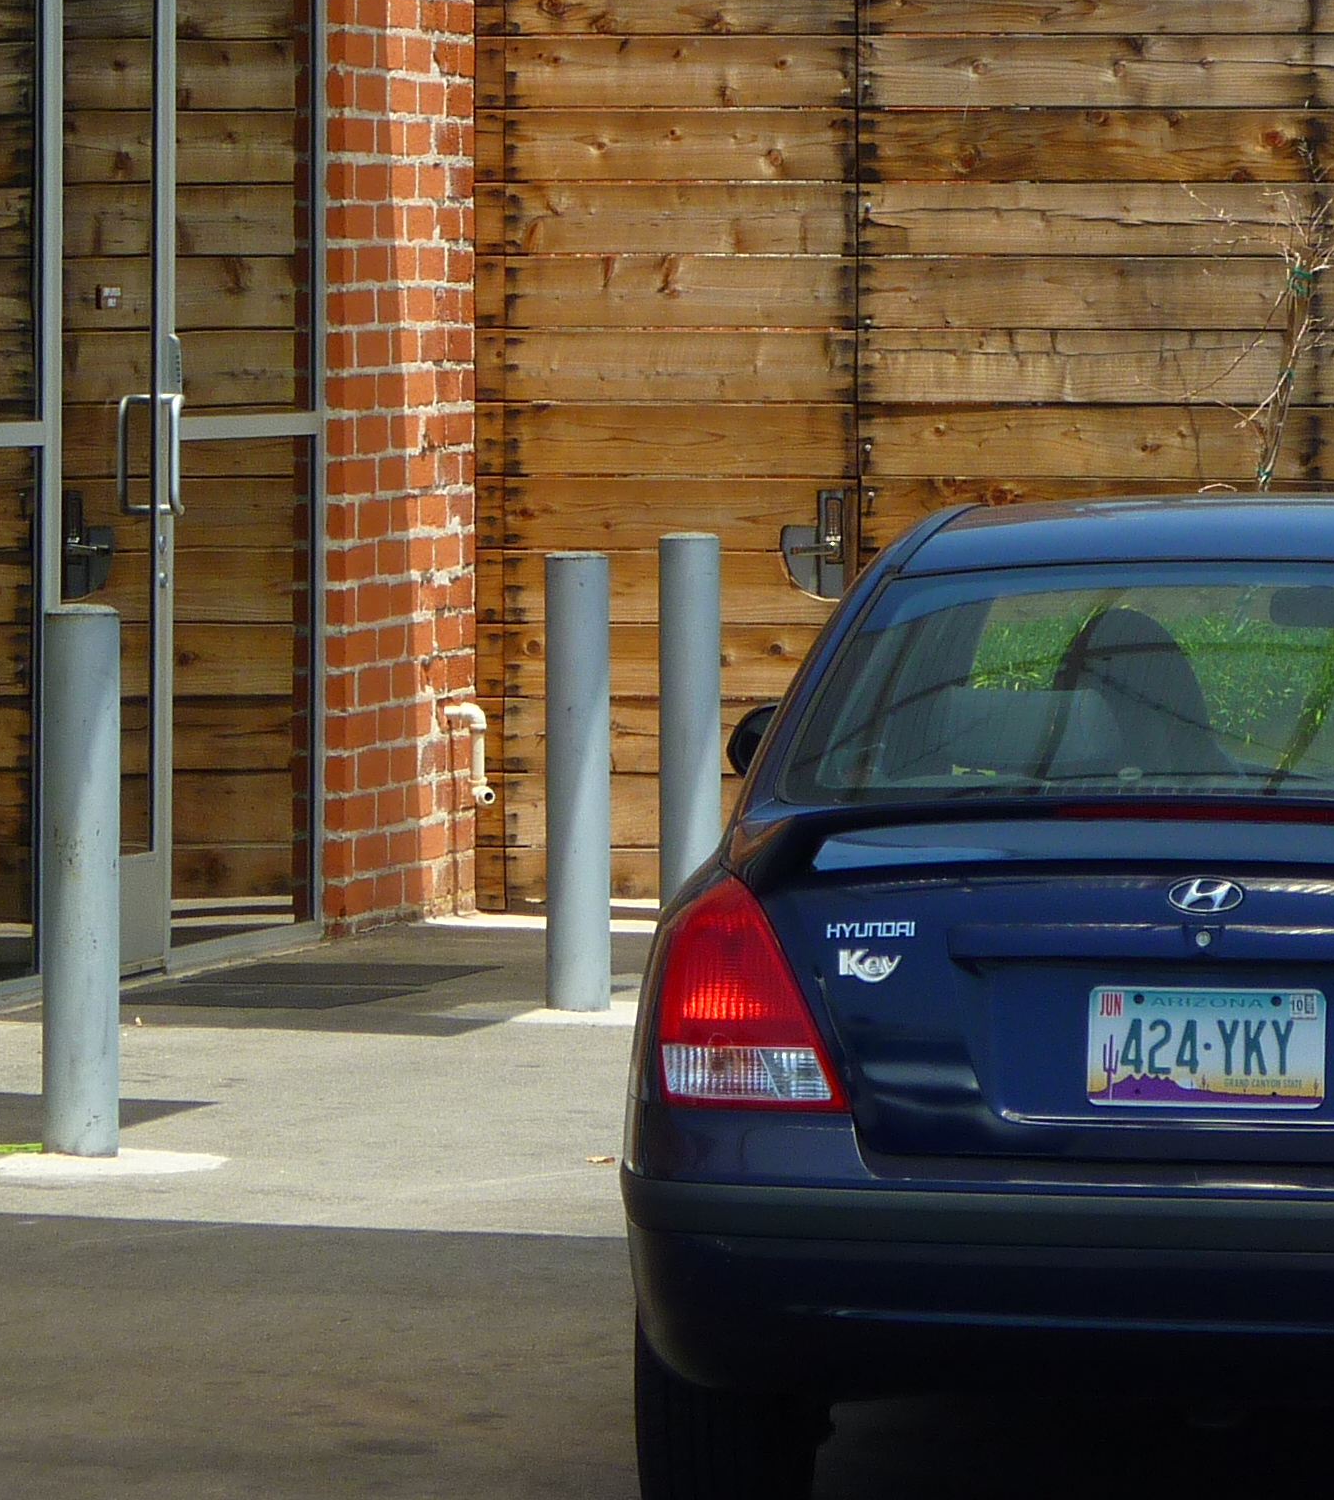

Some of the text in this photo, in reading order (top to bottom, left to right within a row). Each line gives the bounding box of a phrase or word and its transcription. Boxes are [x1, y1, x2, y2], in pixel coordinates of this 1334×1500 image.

[826, 921, 916, 939] HYUNDAI
[1099, 993, 1122, 1016] JUN
[1149, 996, 1264, 1009] ARIZONA
[1224, 1077, 1250, 1088] GRAND
